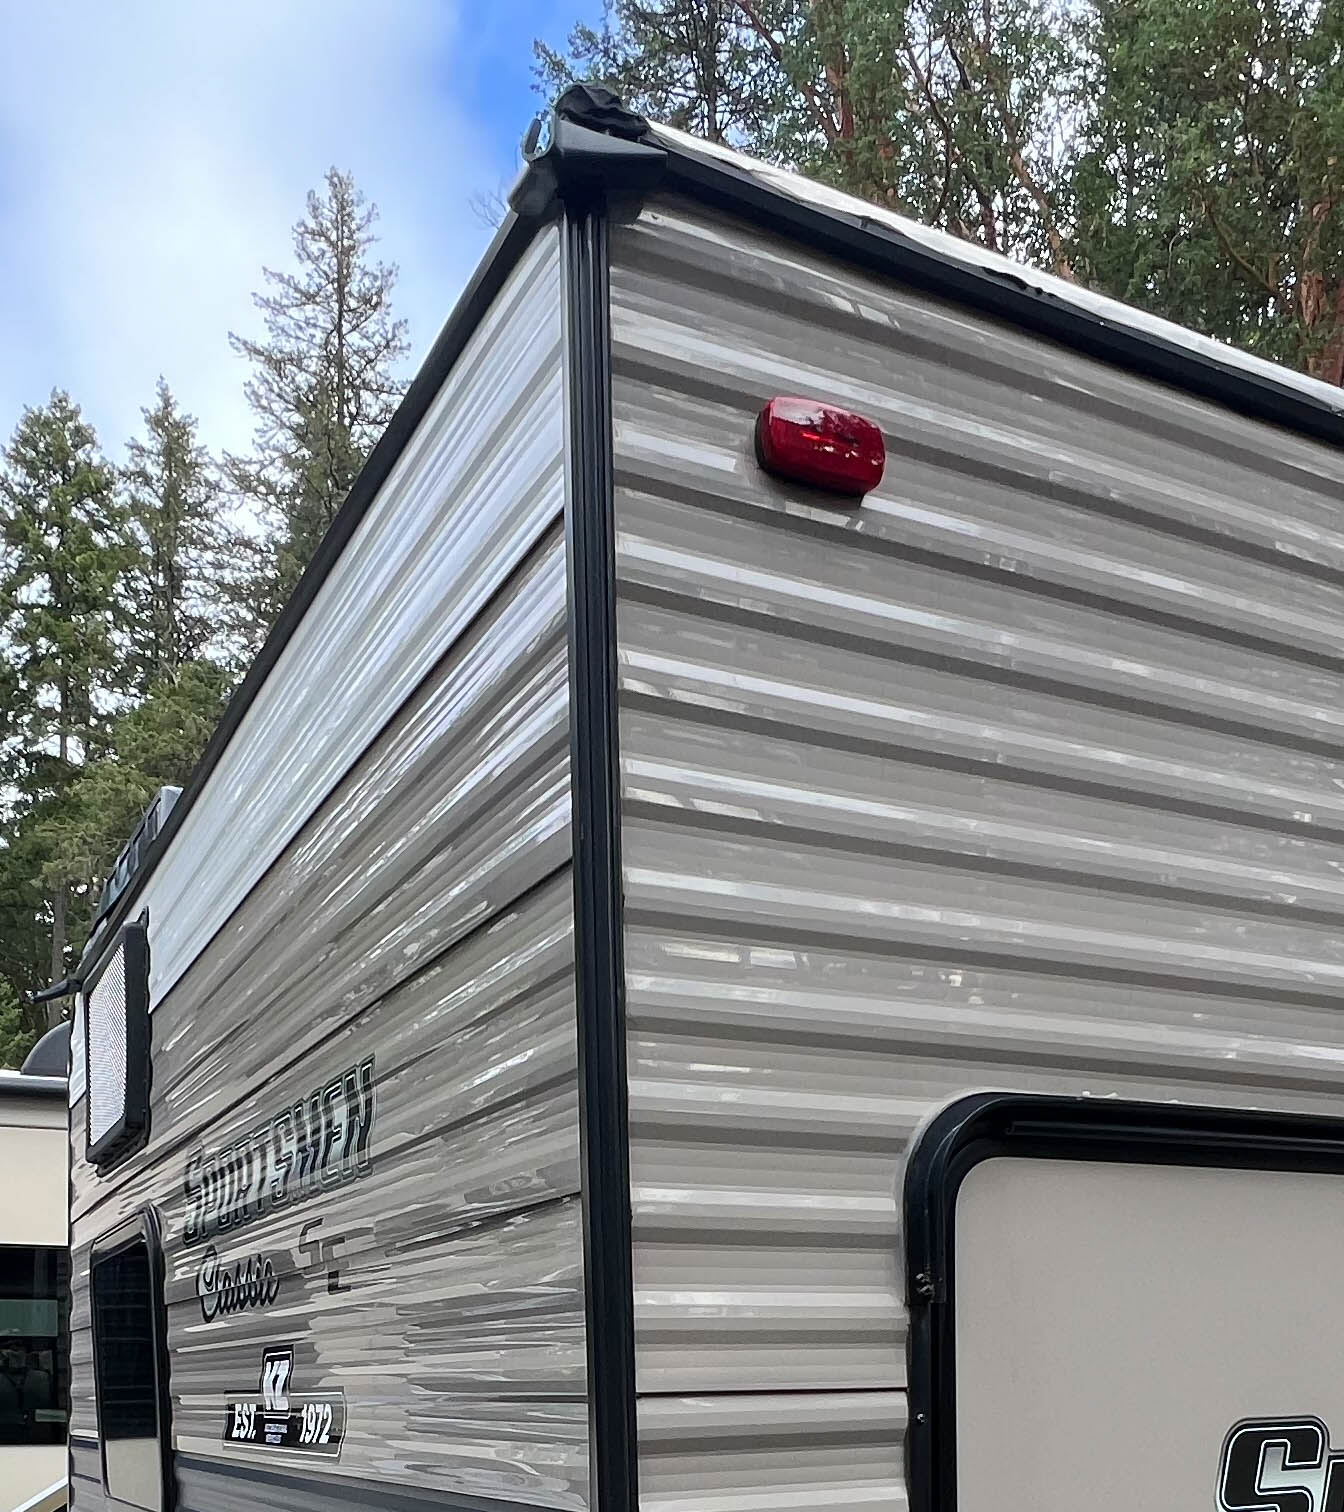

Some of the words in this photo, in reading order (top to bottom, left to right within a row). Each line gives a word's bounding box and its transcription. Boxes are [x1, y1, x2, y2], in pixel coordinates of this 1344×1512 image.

[196, 1245, 280, 1323] Classic
[263, 1360, 290, 1411] KZ
[232, 1403, 257, 1439] EST.
[299, 1403, 333, 1444] 1972
